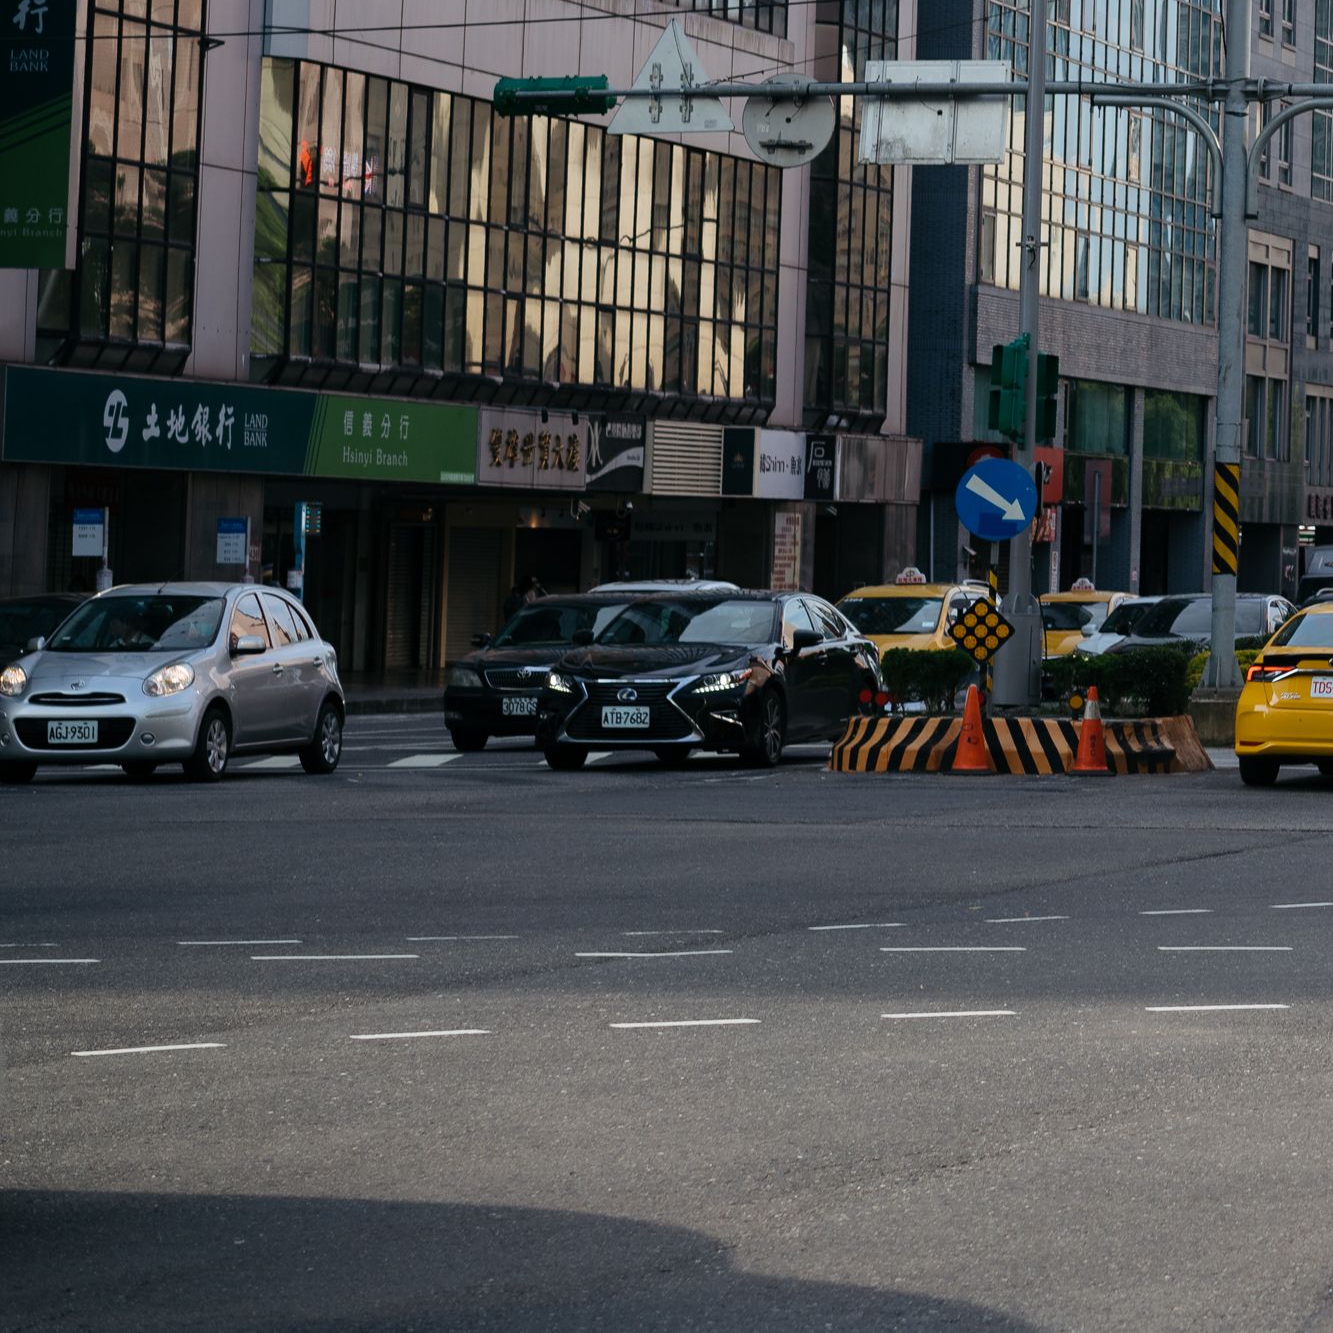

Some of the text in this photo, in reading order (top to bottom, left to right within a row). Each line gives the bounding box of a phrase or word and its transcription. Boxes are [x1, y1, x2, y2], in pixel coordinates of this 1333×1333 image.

[10, 49, 49, 60] LAND
[10, 60, 49, 72] BANK
[142, 403, 234, 451] 土地銀行
[244, 413, 268, 429] LAND
[343, 410, 410, 441] 信義分行
[244, 431, 268, 447] BANK
[342, 446, 408, 467] Hsinyi Branch
